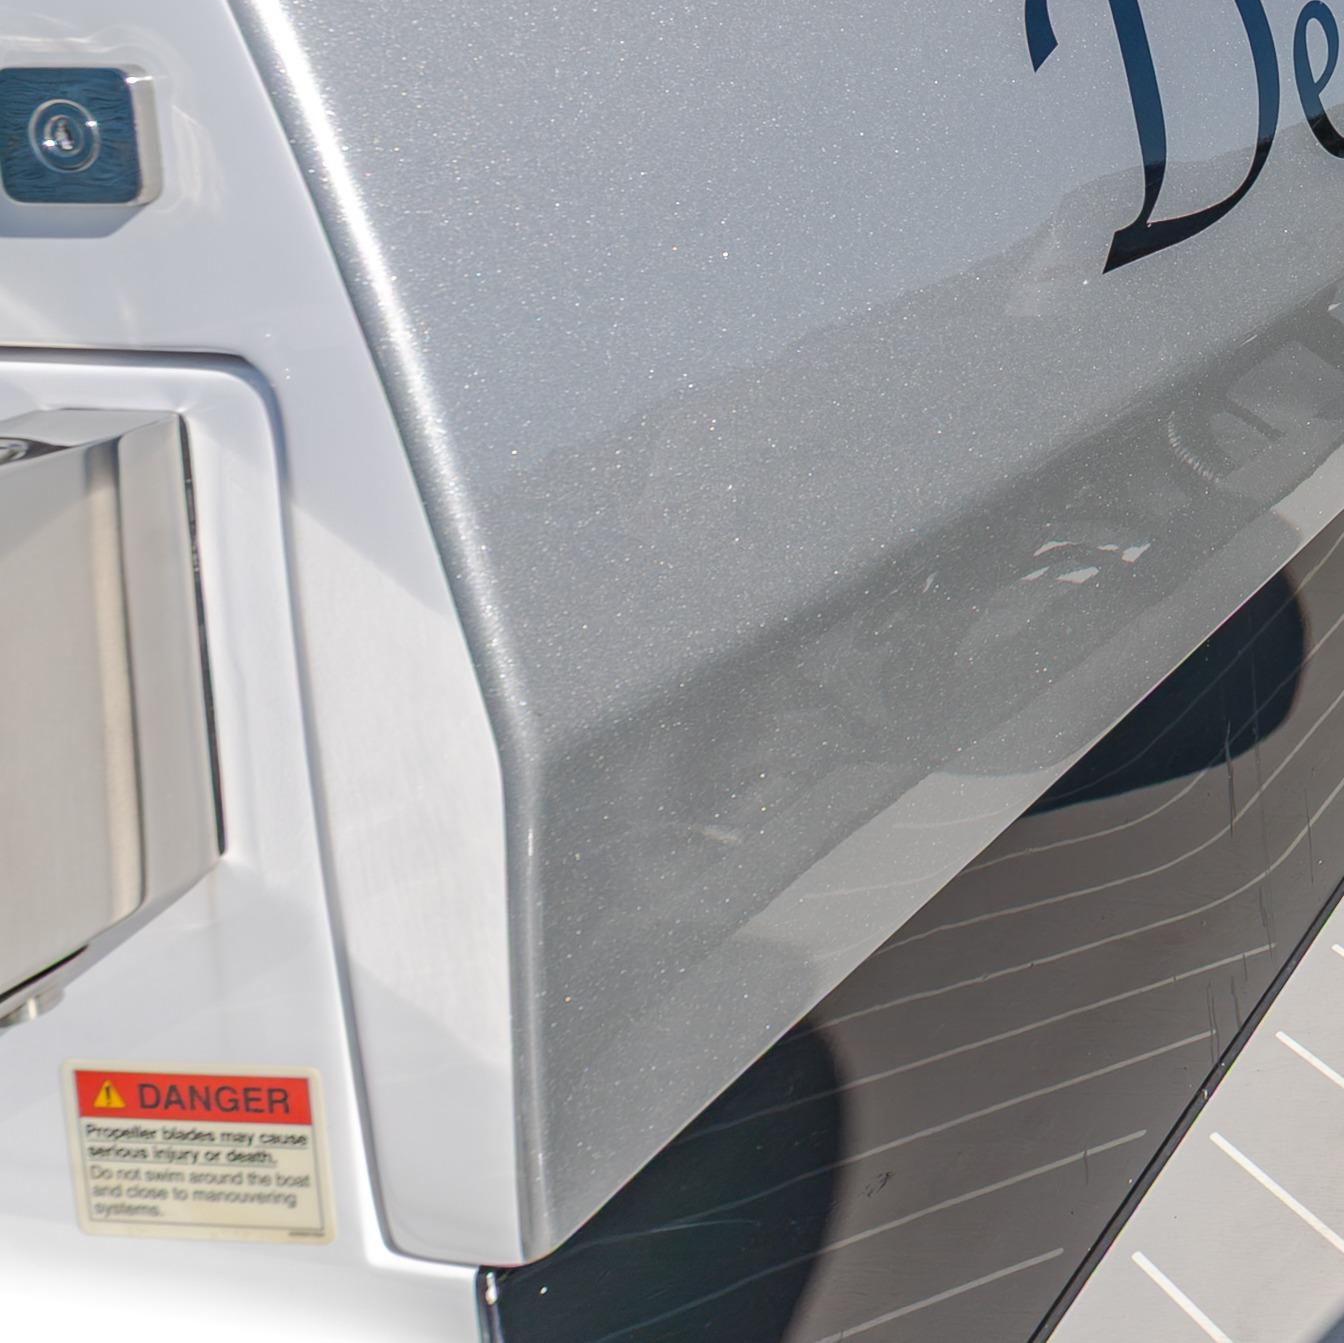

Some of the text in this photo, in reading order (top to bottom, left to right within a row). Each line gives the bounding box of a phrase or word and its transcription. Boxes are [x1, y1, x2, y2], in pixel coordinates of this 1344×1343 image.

[137, 1083, 290, 1115] DANGER
[86, 1124, 309, 1146] Propeller blades may cause
[88, 1145, 277, 1163] serious injury or death.
[90, 1165, 310, 1187] Do not swim around the boat
[93, 1184, 122, 1198] and
[126, 1186, 168, 1200] close
[173, 1187, 188, 1201] to
[94, 1202, 164, 1218] systems.
